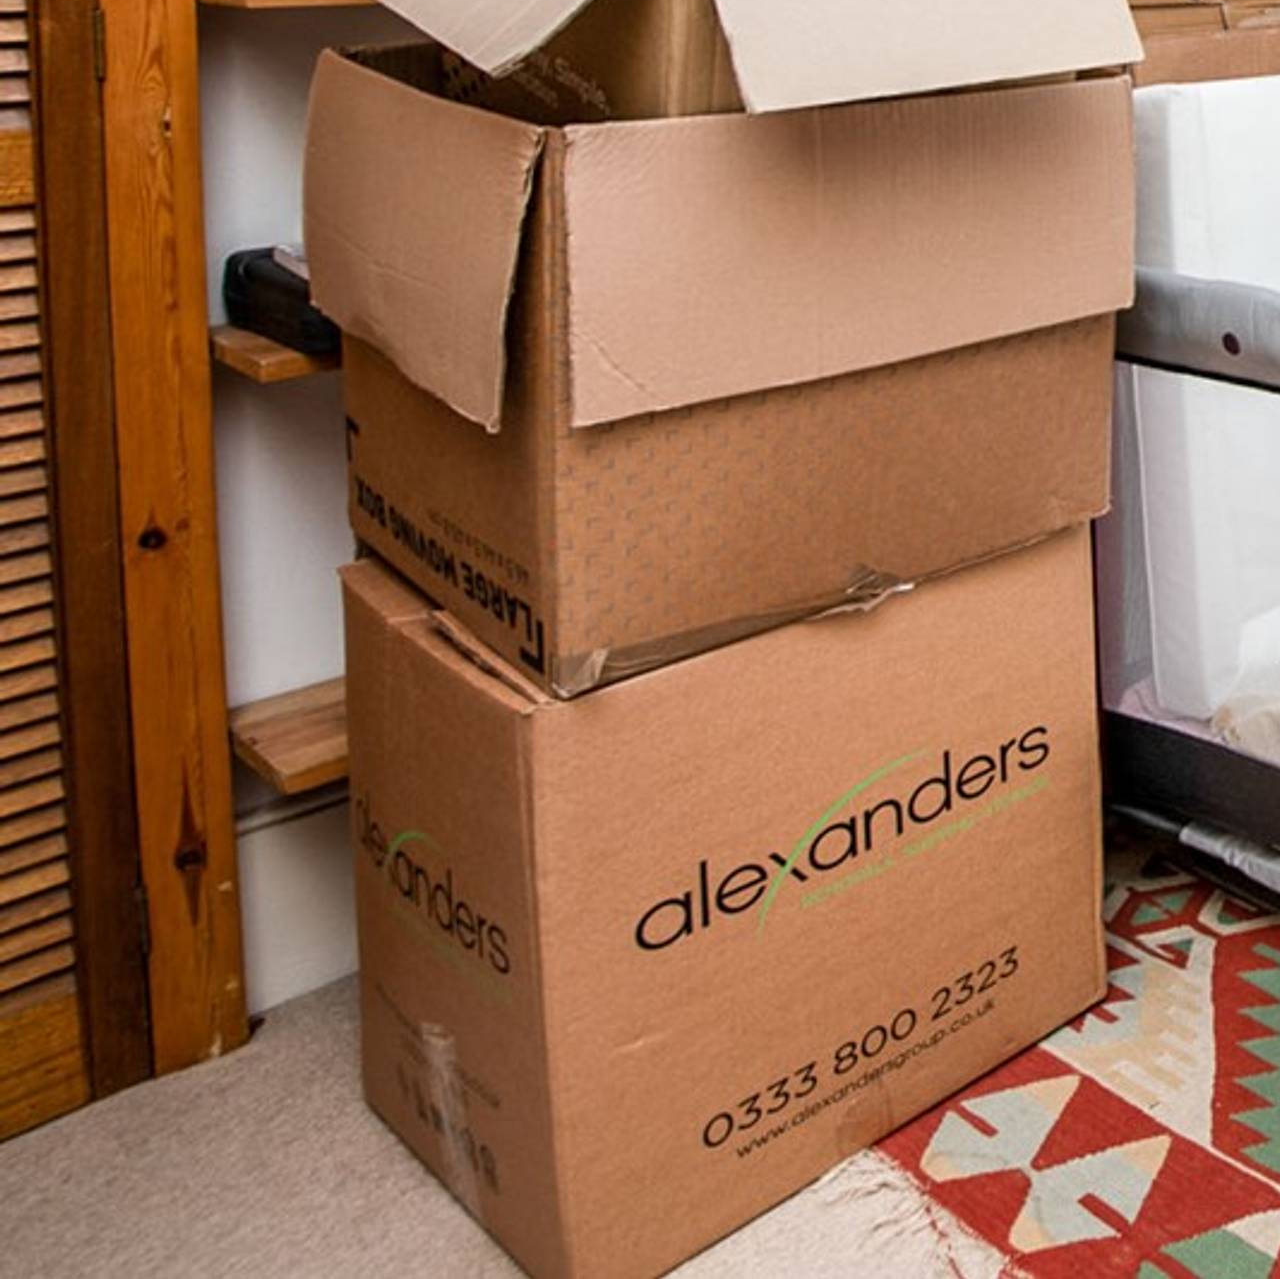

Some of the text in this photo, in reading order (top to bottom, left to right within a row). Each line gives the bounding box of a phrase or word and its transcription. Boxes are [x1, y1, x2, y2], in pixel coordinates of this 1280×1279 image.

[354, 473, 387, 529] BOX
[387, 504, 459, 588] MOVING
[461, 561, 534, 643] LARGE
[634, 725, 1051, 951] alexanders
[701, 944, 1020, 1150] 0333 800 2323
[735, 997, 997, 1159] www.alexandersgroup.co.uk
